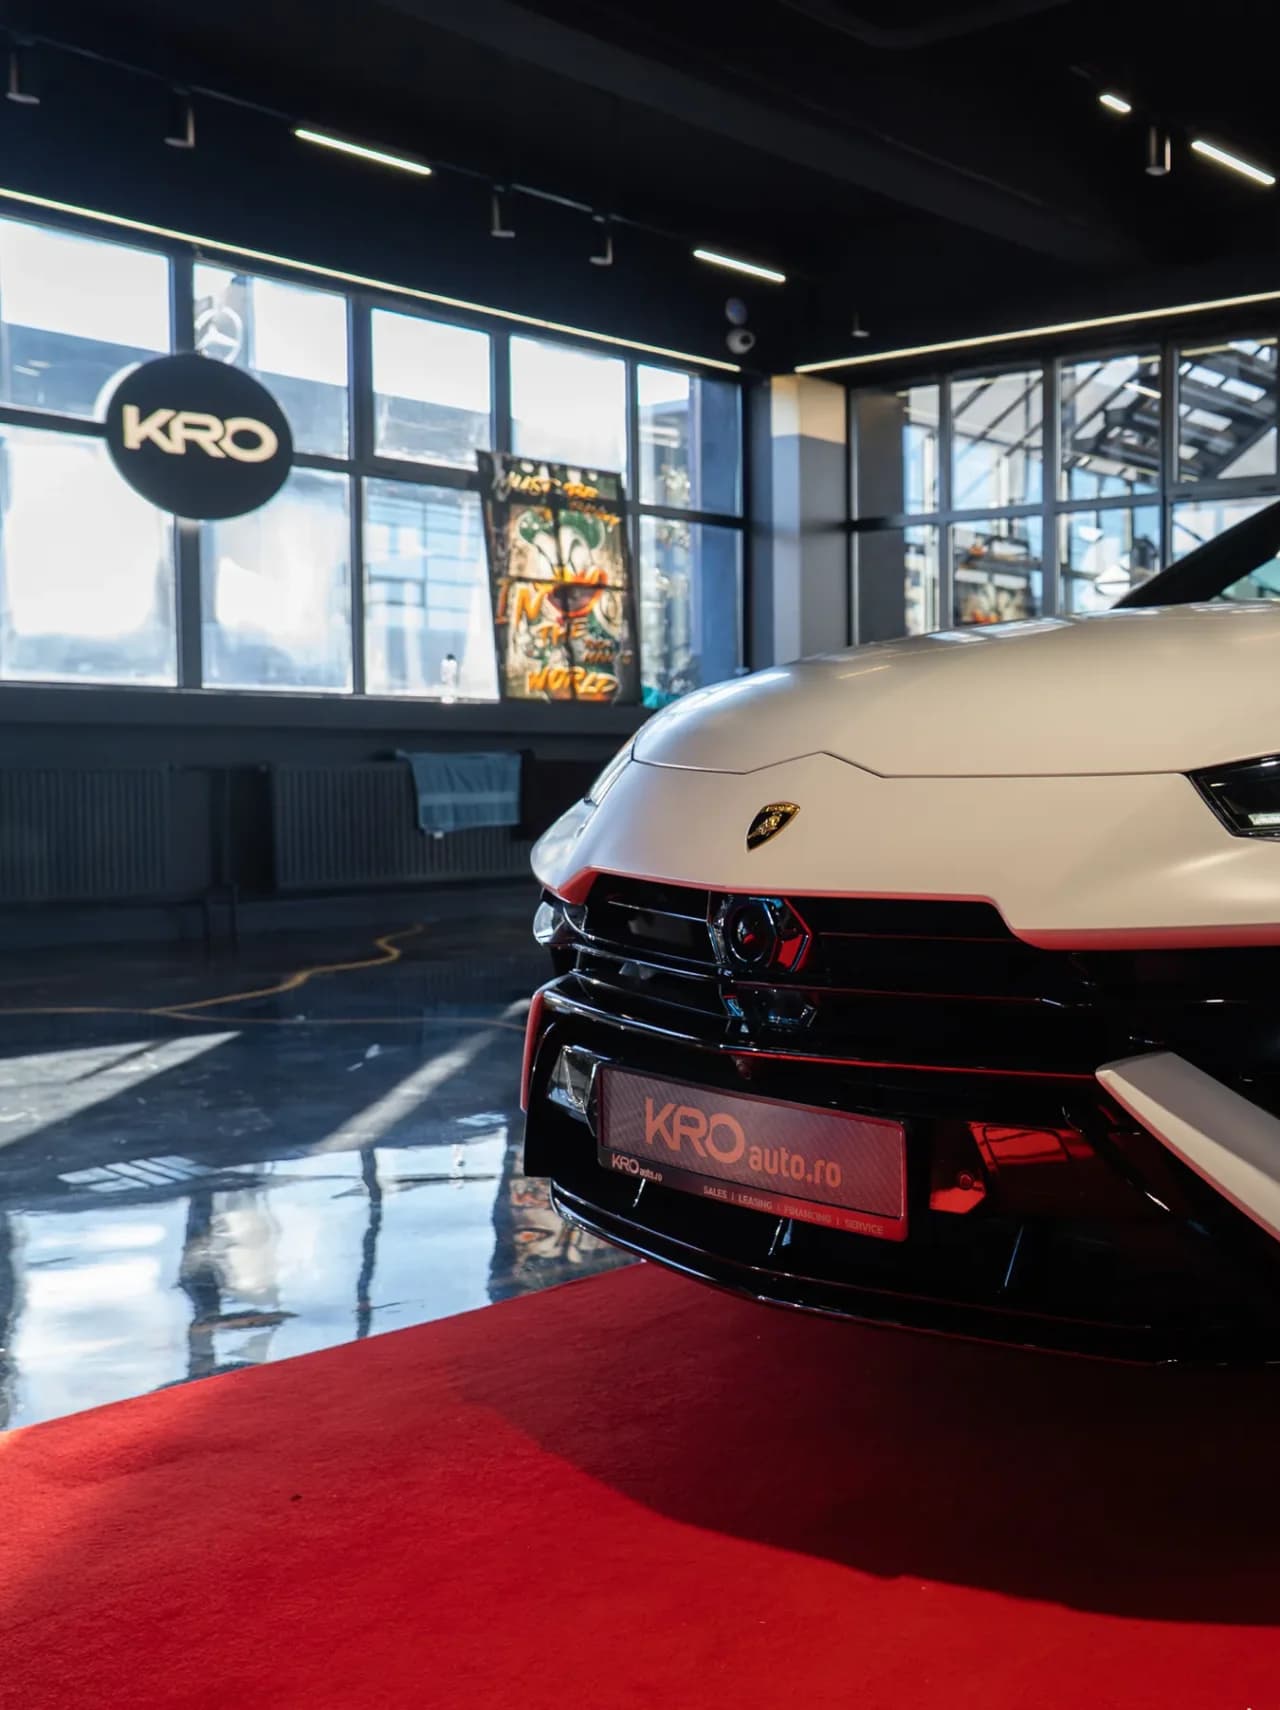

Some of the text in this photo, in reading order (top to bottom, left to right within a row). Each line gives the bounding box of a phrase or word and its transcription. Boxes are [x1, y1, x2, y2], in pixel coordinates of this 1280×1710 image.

[121, 403, 279, 463] KRO
[527, 666, 619, 696] WORLD
[611, 1153, 640, 1175] KRO
[644, 1096, 843, 1189] KRO auto.ro
[703, 1185, 728, 1200] SALES
[738, 1193, 773, 1211] LEASING
[844, 1217, 885, 1236] SERVICE
